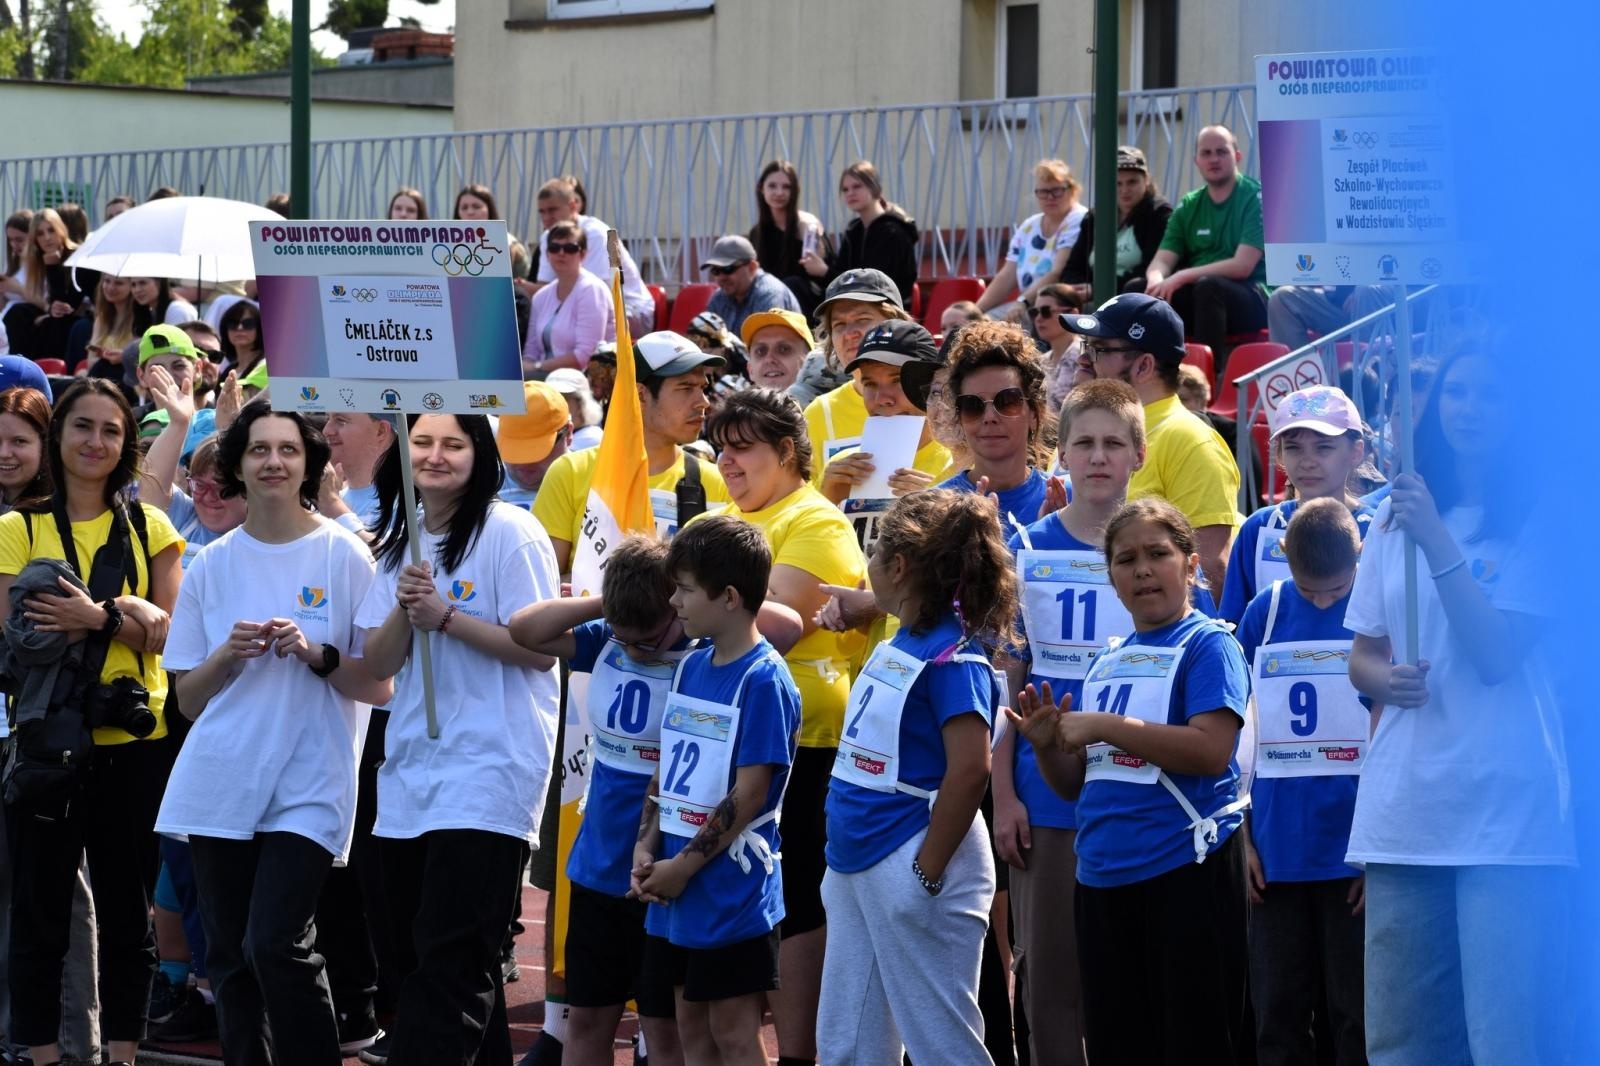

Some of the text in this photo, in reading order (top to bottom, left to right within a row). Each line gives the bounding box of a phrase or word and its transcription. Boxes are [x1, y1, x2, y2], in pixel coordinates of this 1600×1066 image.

[1268, 58, 1378, 81] POWIATOWA
[1279, 81, 1309, 96] OSÓB
[1347, 159, 1379, 176] Zespół
[1350, 196, 1430, 213] Rewalidacyjnych
[1336, 218, 1343, 228] w
[1346, 214, 1404, 229] Wodzisławiu
[261, 226, 476, 244] POWIATOWA OLIMPIADA
[274, 243, 424, 256] OSÓB NIEPEŁNOSPRAWNYCH
[387, 289, 443, 299] OLIMPIADA
[344, 318, 433, 341] ČMELÁČEK z.s
[366, 345, 418, 362] Ostrava
[1056, 588, 1097, 641] 11
[606, 679, 652, 735] 10
[846, 685, 874, 739] 2
[1288, 681, 1318, 737] 9
[641, 750, 659, 759] EFE
[1114, 755, 1142, 766] EFEKT
[1327, 751, 1355, 759] EFEKT
[662, 739, 701, 797] 12
[856, 760, 881, 773] EFEKT
[681, 813, 704, 823] EFEKT
